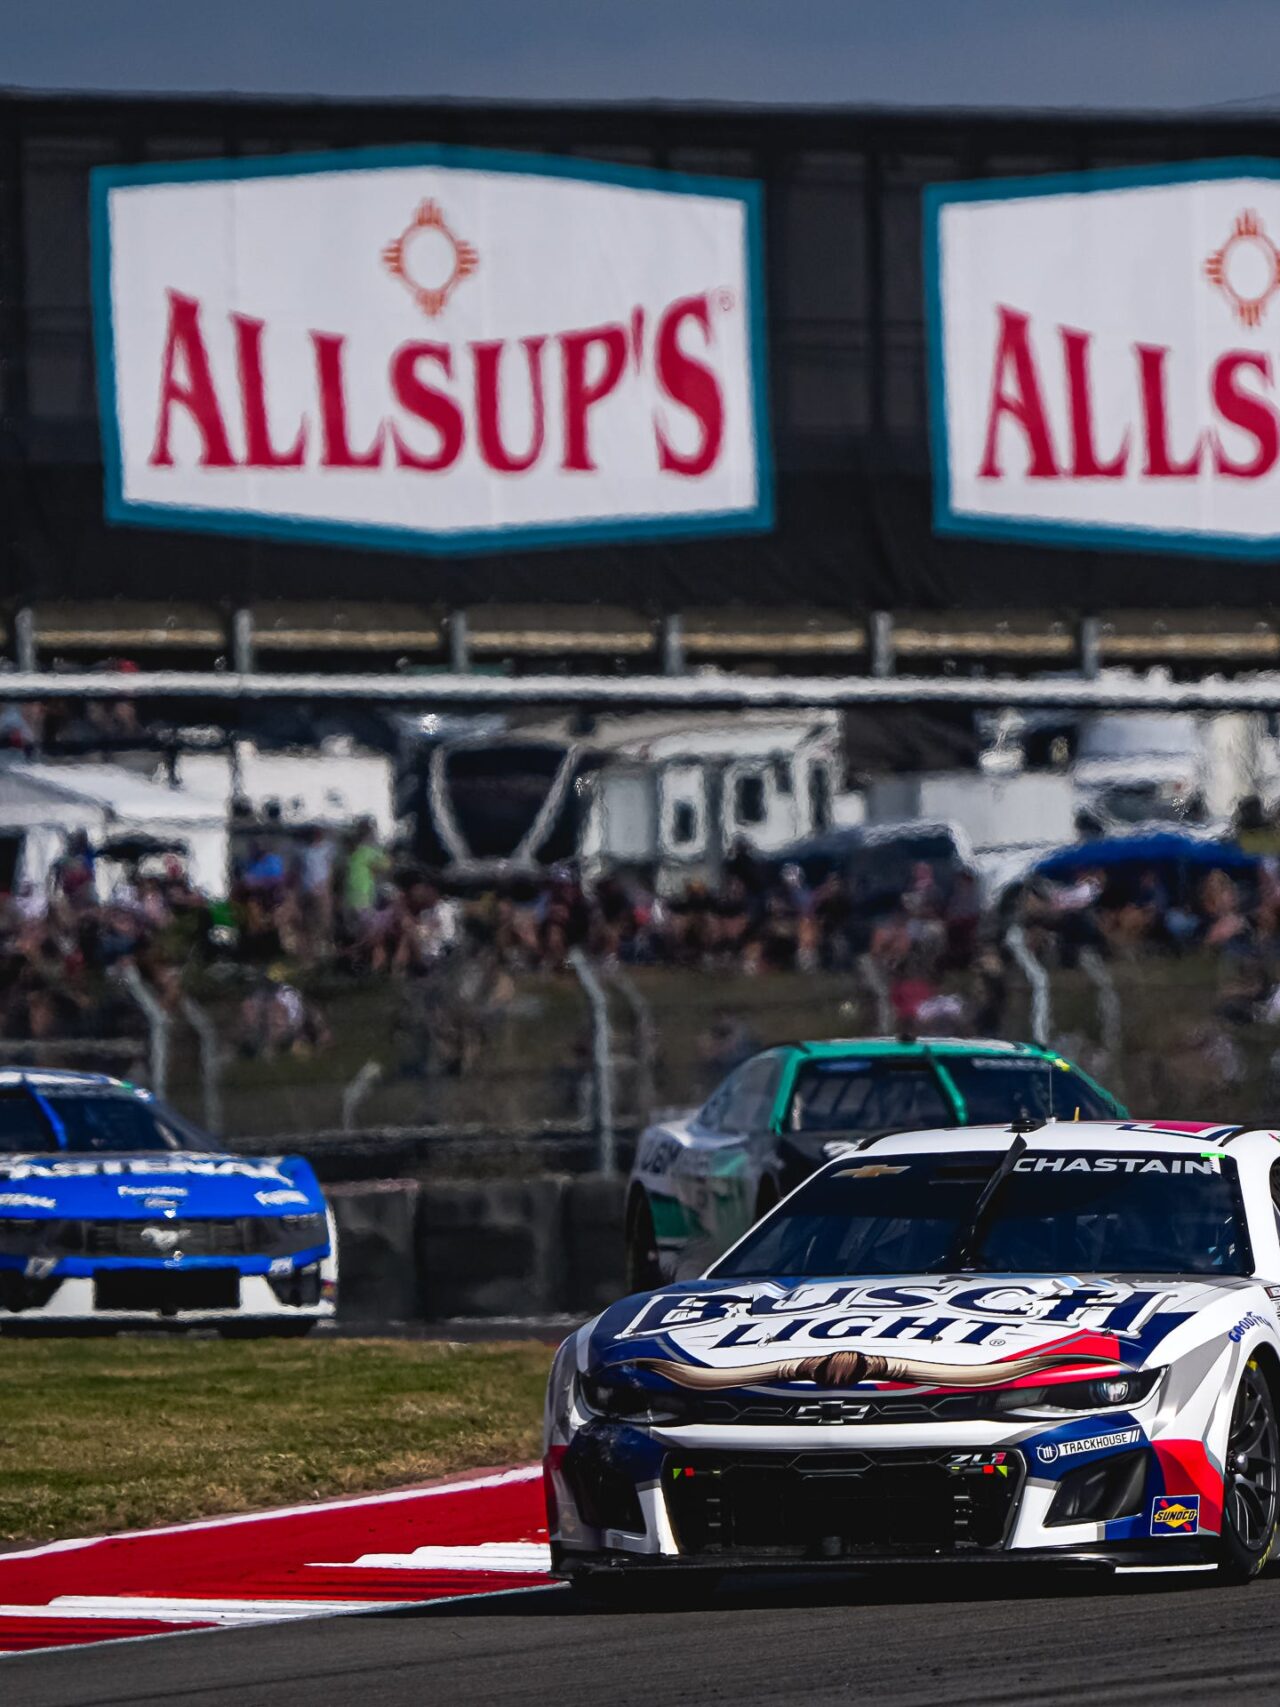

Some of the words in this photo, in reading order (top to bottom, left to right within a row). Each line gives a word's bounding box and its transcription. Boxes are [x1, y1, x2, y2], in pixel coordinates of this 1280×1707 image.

[149, 286, 724, 477] ALLSUP'S
[1012, 1158, 1212, 1174] CHASTAIN
[612, 1284, 1178, 1339] BUSCH
[708, 1315, 1023, 1350] LIGHT
[1063, 1434, 1128, 1454] TRACKHOUSE
[1156, 1511, 1195, 1521] SUNOCO
